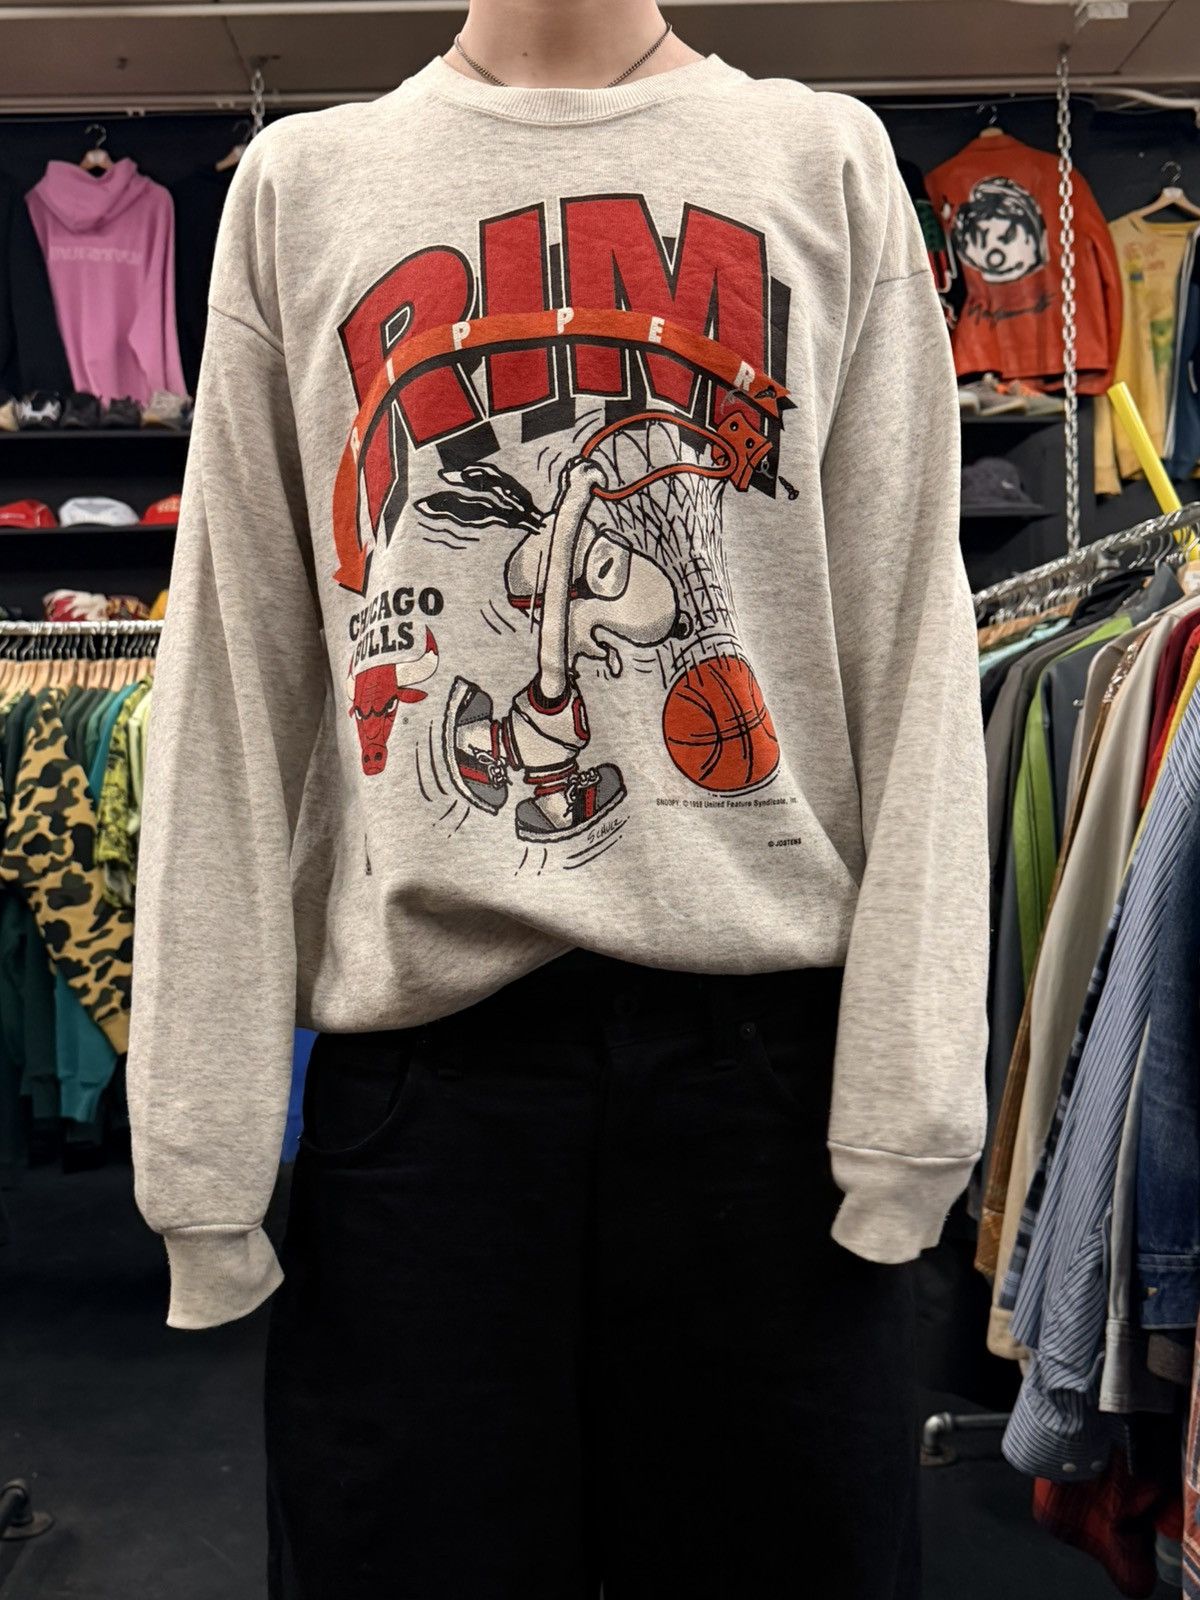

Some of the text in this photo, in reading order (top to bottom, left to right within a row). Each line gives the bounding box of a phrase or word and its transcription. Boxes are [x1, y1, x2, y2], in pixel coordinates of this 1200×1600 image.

[337, 192, 771, 546] RIM
[348, 586, 444, 641] CHICAGO
[354, 621, 415, 668] BULLS
[704, 800, 725, 808] United
[726, 800, 752, 808] Feature
